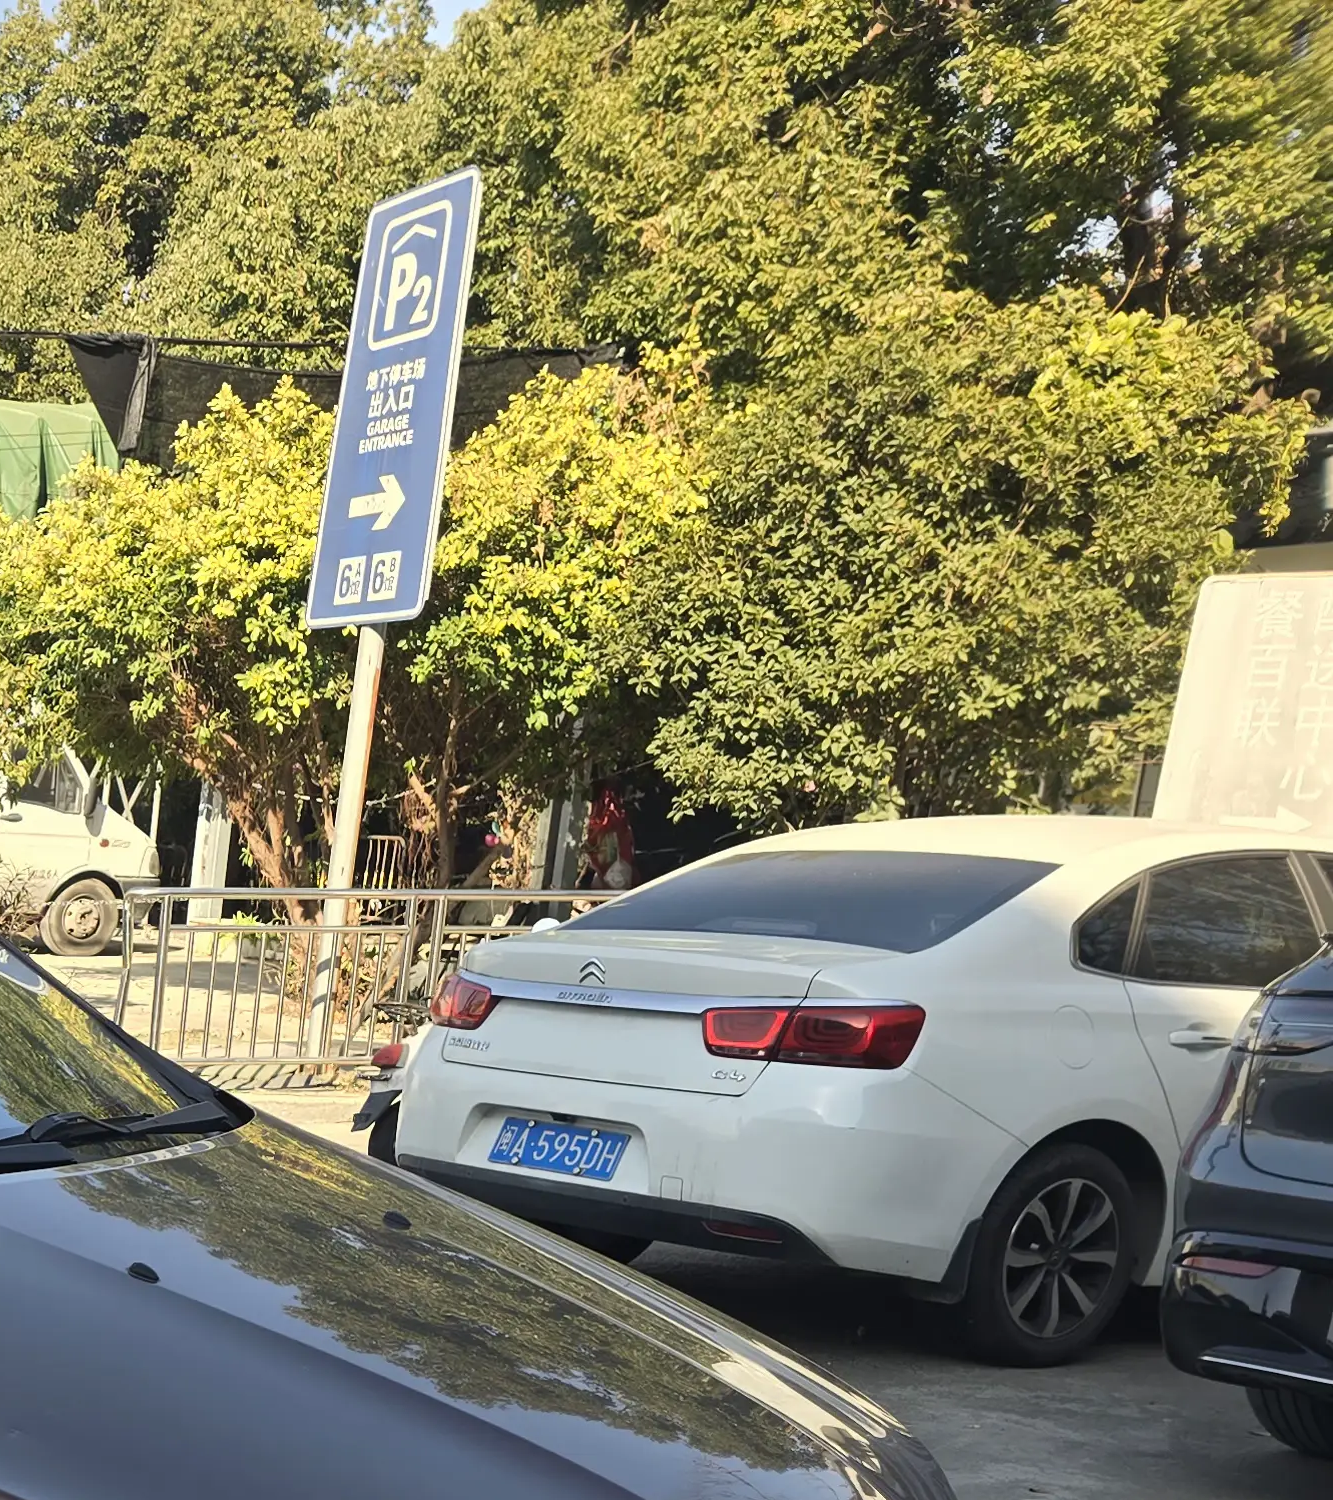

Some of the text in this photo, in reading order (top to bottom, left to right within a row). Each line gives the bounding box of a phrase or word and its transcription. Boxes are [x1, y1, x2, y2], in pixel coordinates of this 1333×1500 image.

[384, 252, 432, 331] P2
[368, 384, 415, 418] 出入口
[367, 414, 410, 437] GARAGE
[359, 430, 414, 454] ENTRANCE
